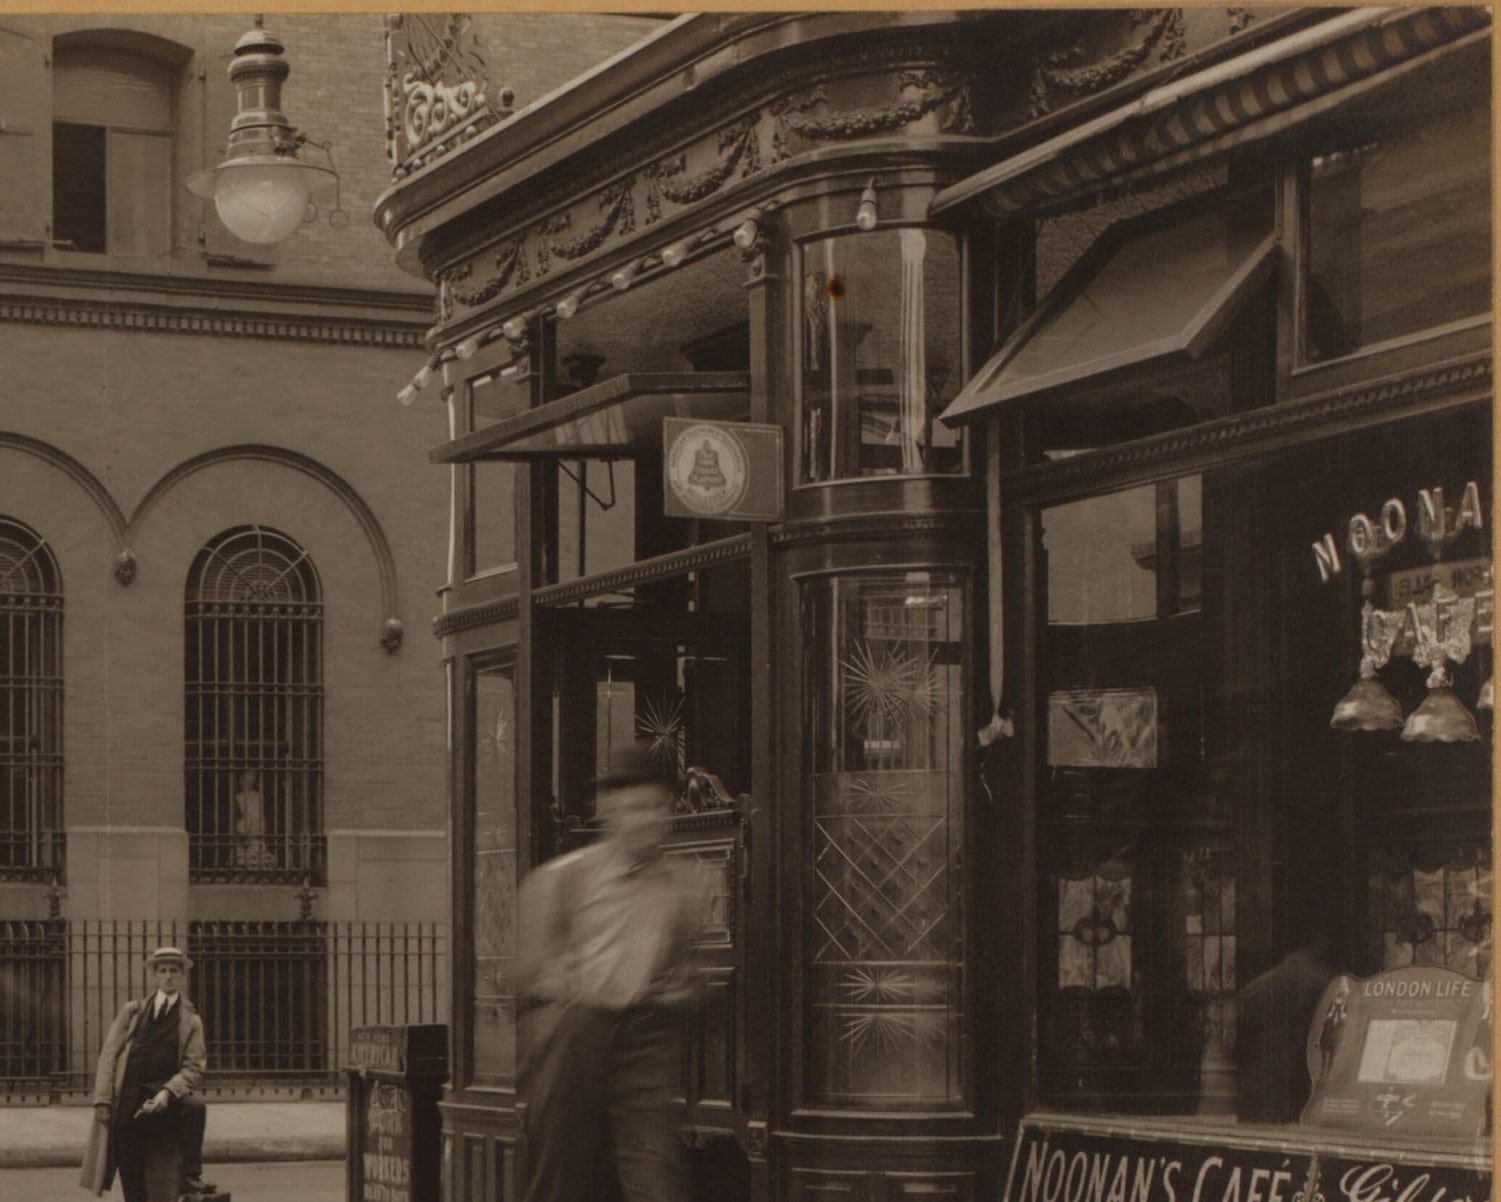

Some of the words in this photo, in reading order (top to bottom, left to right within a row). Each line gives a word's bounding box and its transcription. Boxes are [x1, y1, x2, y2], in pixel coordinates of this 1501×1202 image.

[1364, 981, 1432, 997] LONDON
[1436, 981, 1473, 997] LIFE
[363, 1152, 410, 1184] WORKERS
